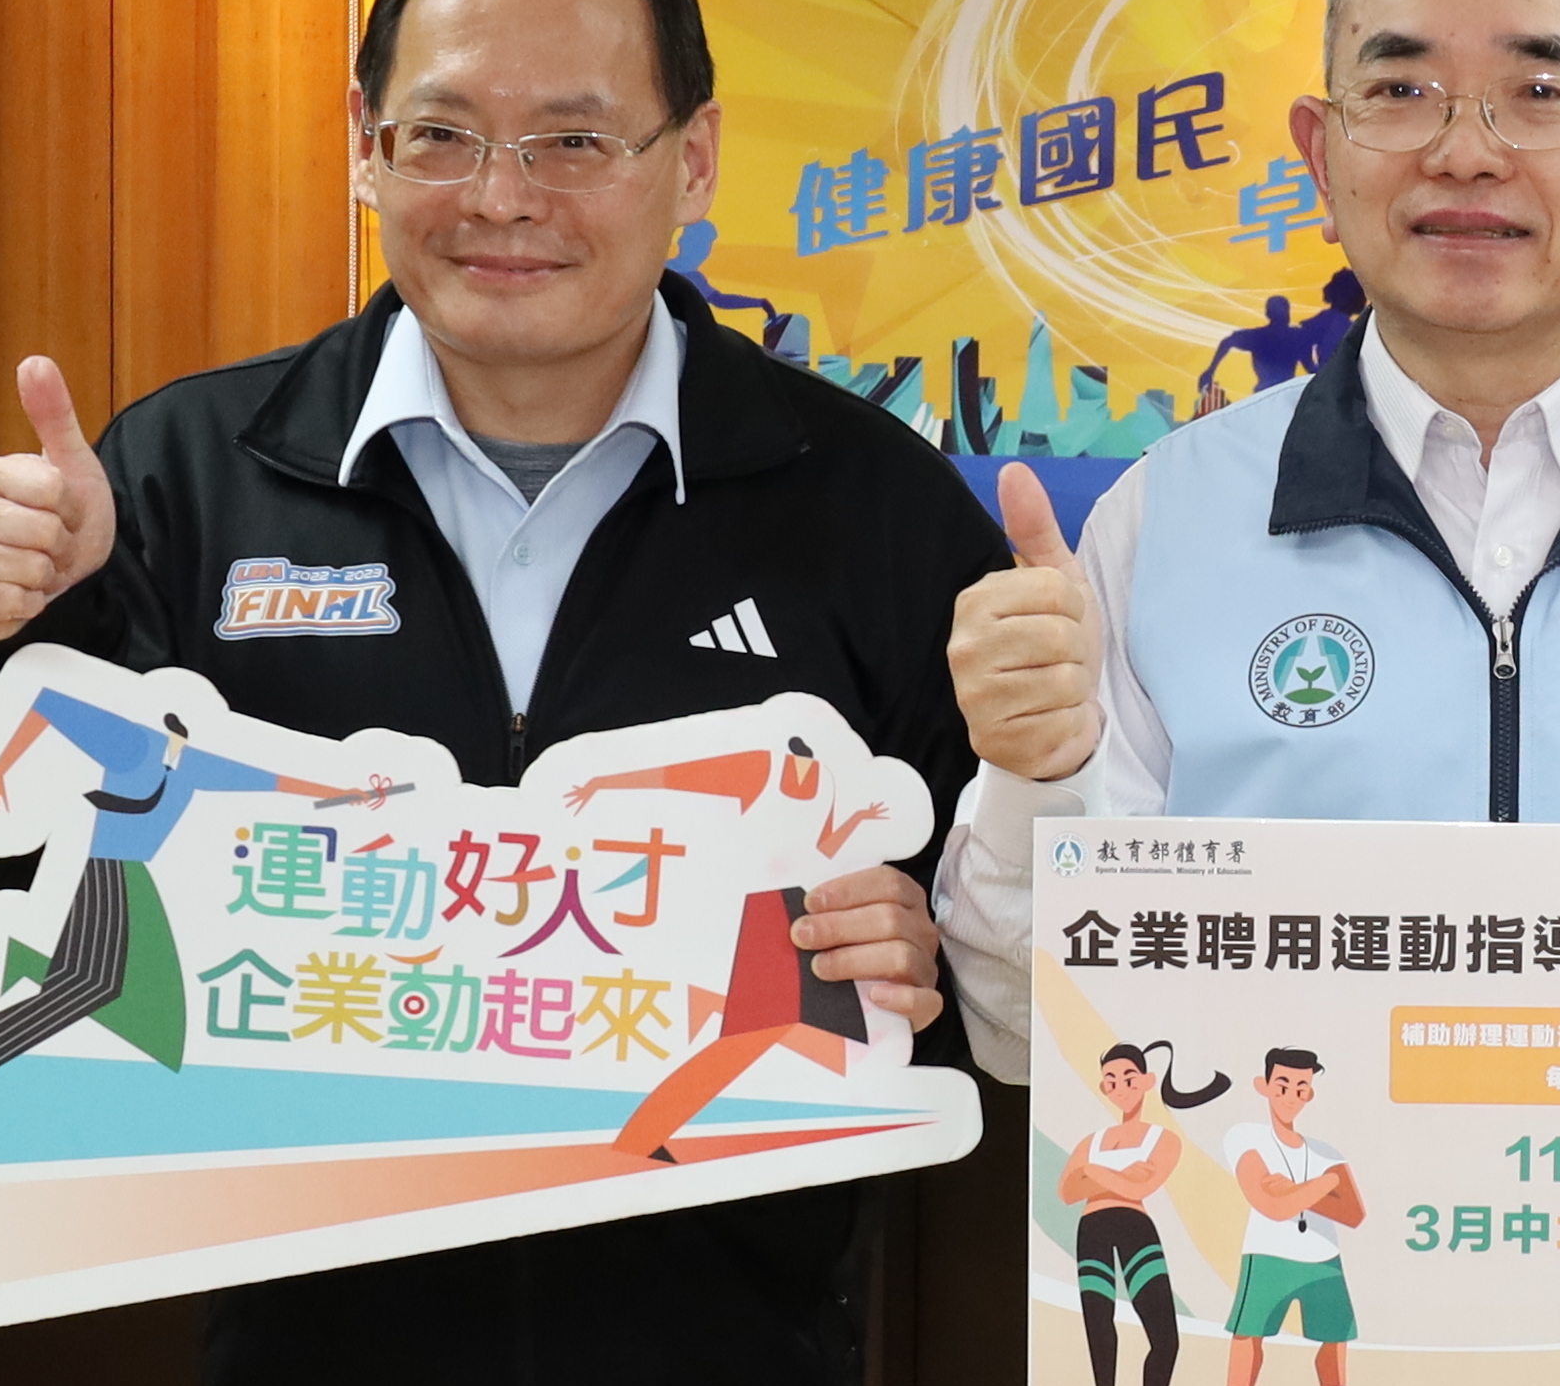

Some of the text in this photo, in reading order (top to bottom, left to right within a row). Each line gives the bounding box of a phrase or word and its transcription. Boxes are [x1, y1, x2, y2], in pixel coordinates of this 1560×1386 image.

[788, 70, 1231, 258] 健康國民
[231, 585, 390, 626] FINAL
[1255, 619, 1369, 703] MINISTRY OF EDUCATION
[225, 823, 687, 959] 運動好人才
[1096, 838, 1246, 863] 教育部體育署
[196, 945, 672, 1061] 企業動起來
